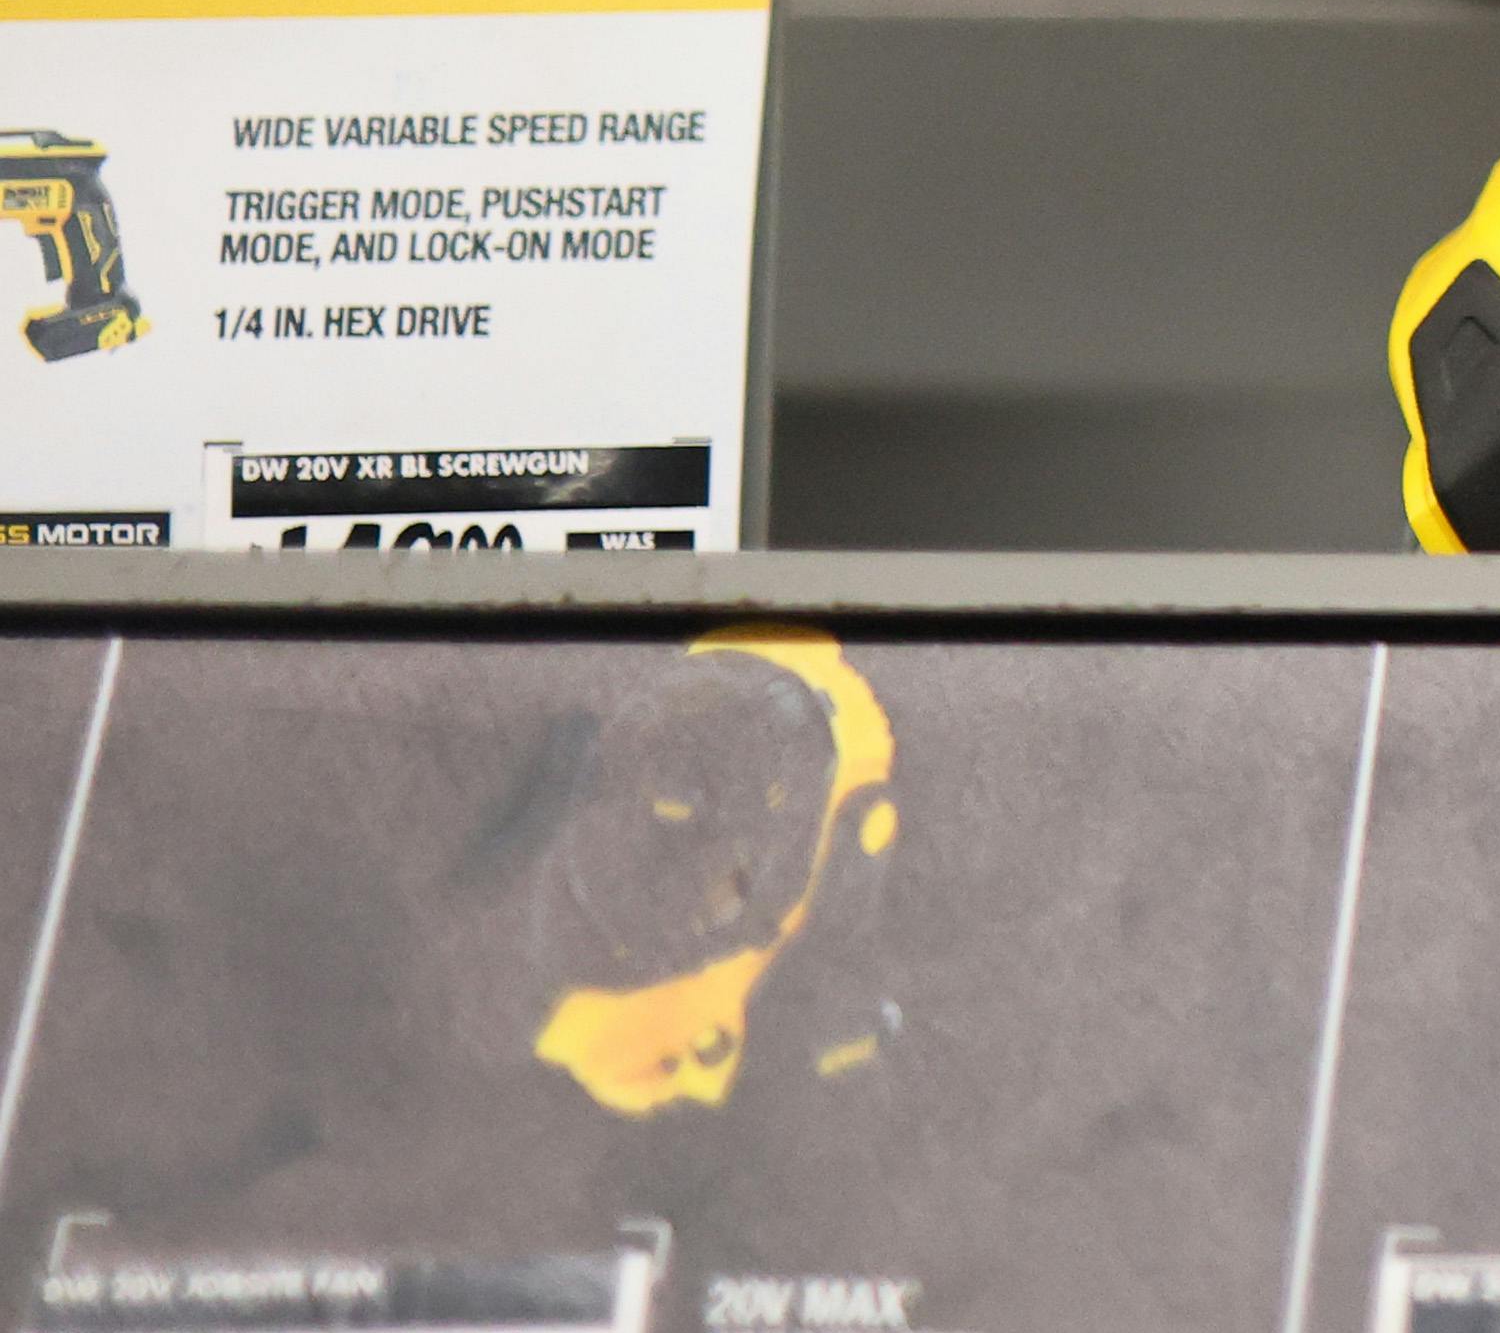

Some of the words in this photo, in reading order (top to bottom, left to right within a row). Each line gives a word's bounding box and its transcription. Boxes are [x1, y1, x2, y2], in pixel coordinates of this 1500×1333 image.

[233, 116, 315, 149] WIDE
[325, 114, 478, 148] VARIABLE
[487, 113, 588, 146] SPEED
[599, 111, 706, 143] RANGE
[226, 190, 360, 222] TRIGGER
[369, 188, 471, 223] MODE,
[481, 185, 667, 220] PUSHSTART
[220, 232, 321, 269] MODE,
[330, 231, 398, 264] AND
[409, 230, 551, 263] LOCK-ON
[561, 229, 656, 260] MODE
[214, 306, 264, 340] 1/4
[274, 306, 314, 339] IN.
[324, 305, 387, 338] HEX
[398, 304, 492, 337] DRIVE
[240, 457, 289, 483] DW
[296, 456, 351, 482] 20V
[356, 456, 394, 480] XR
[400, 455, 433, 480] BL
[438, 451, 590, 479] SCREWGUN
[37, 522, 161, 546] MOTOR
[601, 531, 656, 551] WAS
[703, 1275, 795, 1326] 20V
